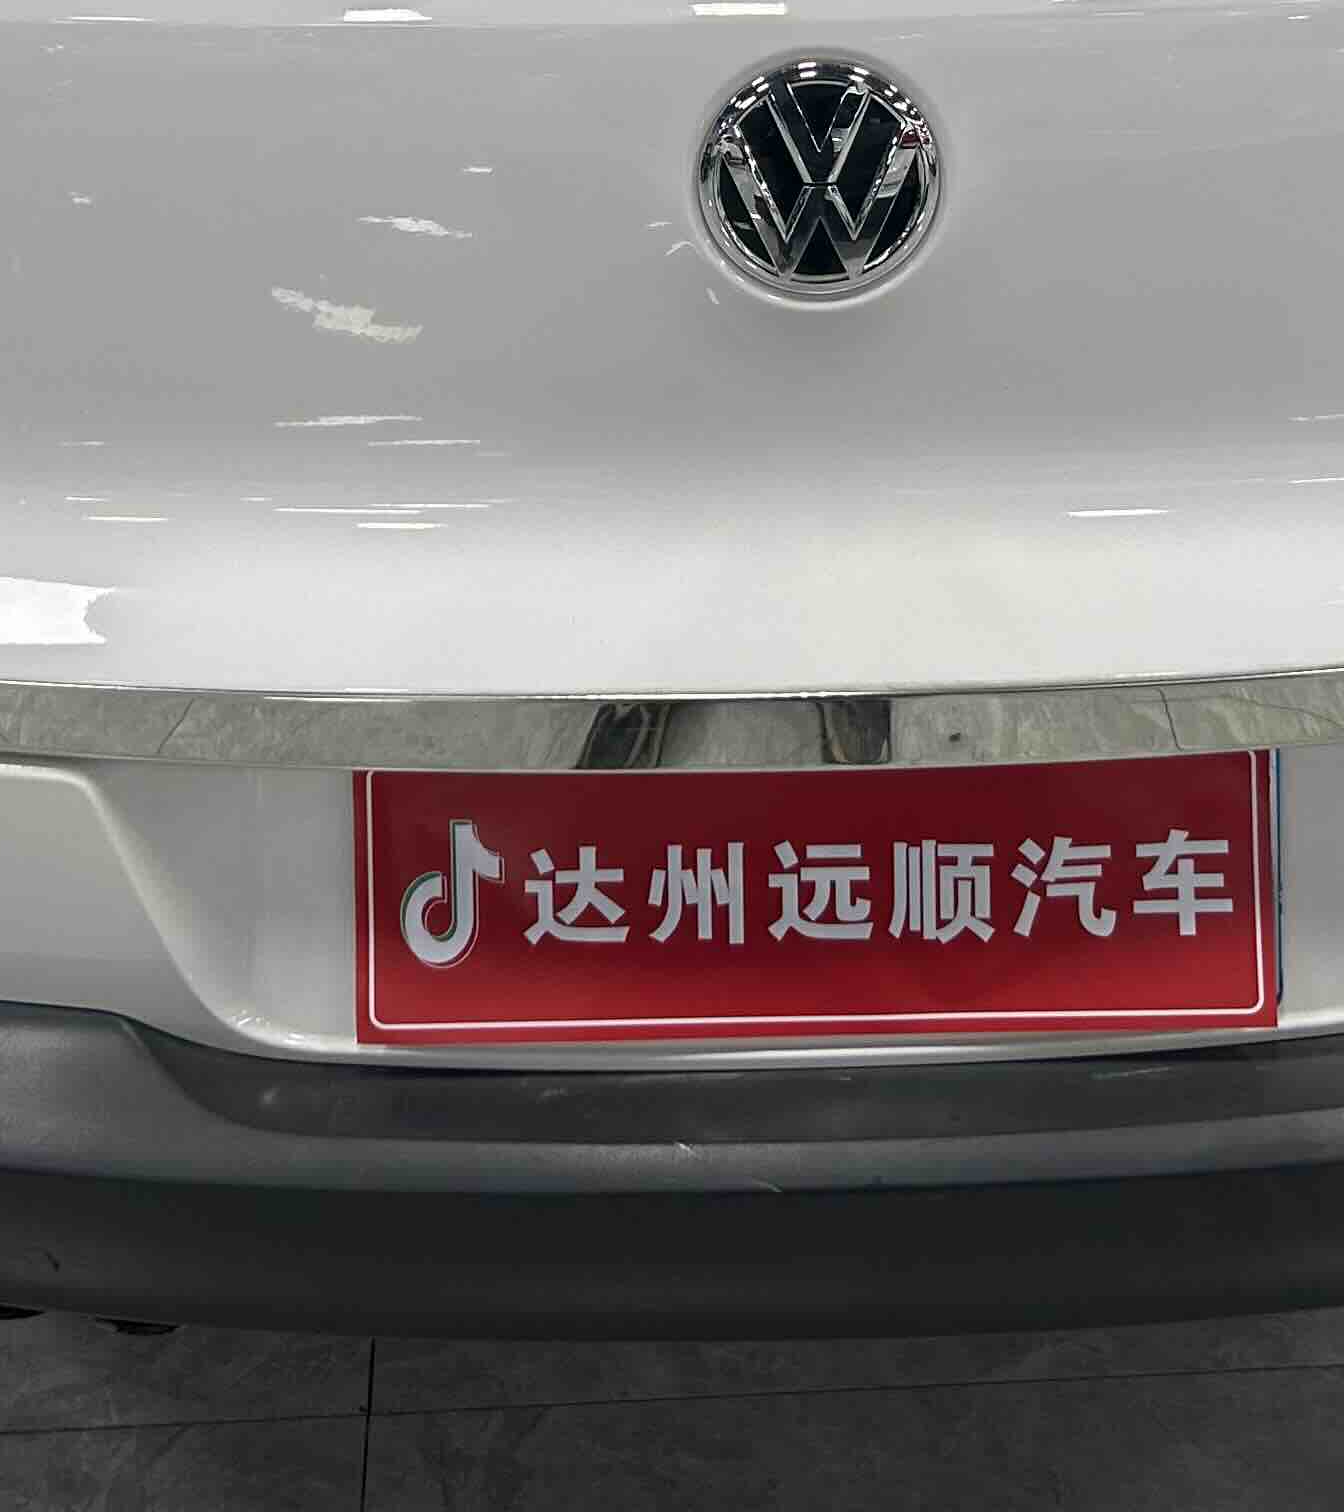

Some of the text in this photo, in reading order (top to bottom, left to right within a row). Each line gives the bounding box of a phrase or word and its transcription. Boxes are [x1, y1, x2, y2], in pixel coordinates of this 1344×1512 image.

[523, 830, 1233, 945] 达州远顺汽车
